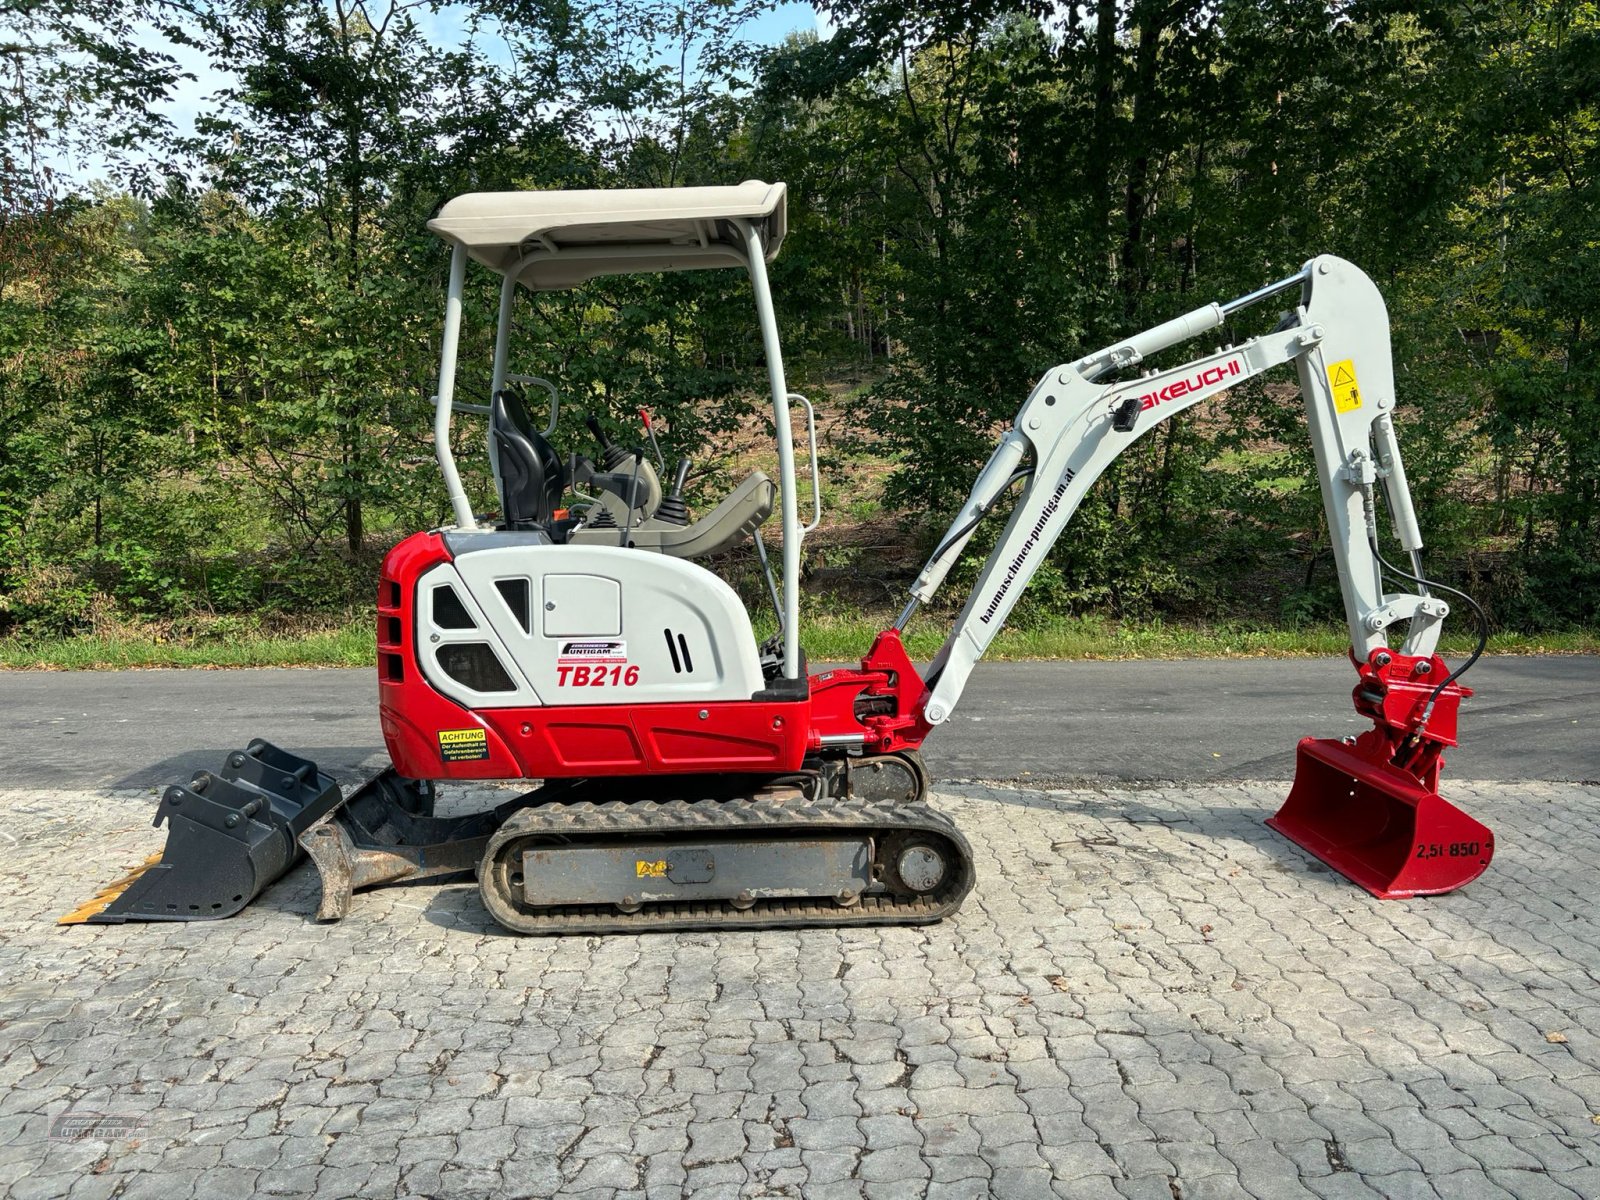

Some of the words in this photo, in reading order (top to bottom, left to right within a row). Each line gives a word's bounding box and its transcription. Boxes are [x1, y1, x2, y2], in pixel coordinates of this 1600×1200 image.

[980, 467, 1076, 625] baumaschinen-puntigam.at
[557, 665, 640, 687] TB216
[441, 731, 484, 741] ACHTUNG
[1449, 842, 1479, 857] 850
